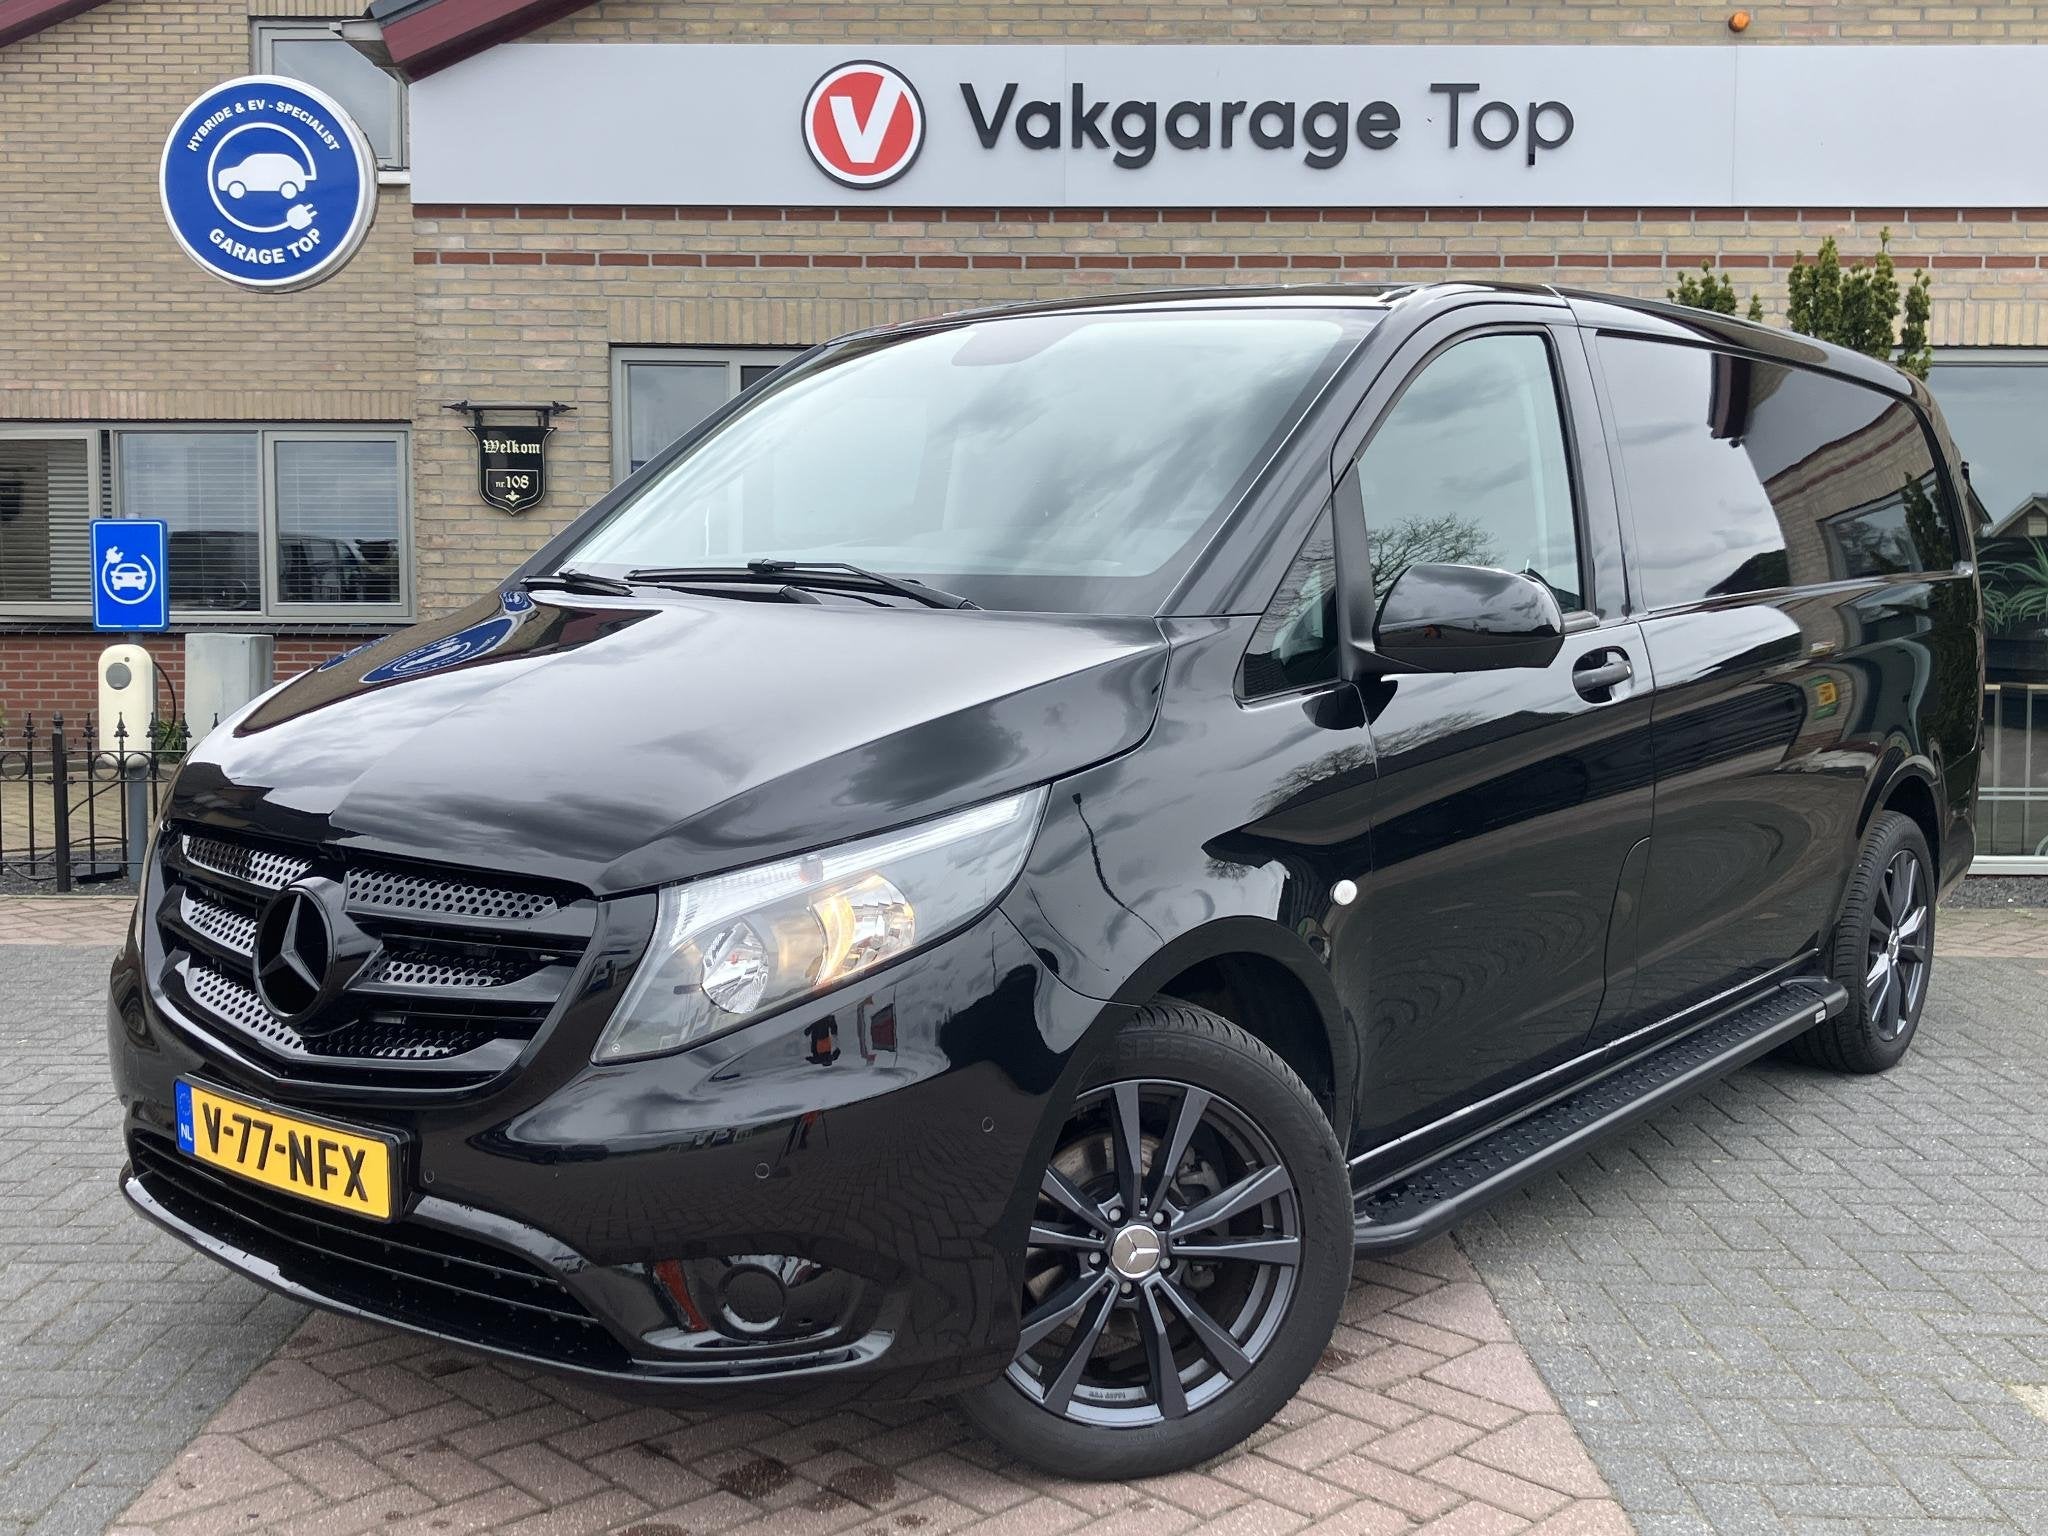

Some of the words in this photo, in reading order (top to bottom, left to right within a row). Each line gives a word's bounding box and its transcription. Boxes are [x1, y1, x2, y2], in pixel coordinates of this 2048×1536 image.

[187, 107, 233, 152] HYBRIDE
[234, 102, 246, 114] &
[248, 99, 266, 111] EV
[276, 101, 341, 151] SPECIALIST
[959, 83, 1401, 169] Vakgarage
[1430, 83, 1574, 166] Top
[209, 228, 286, 265] GARAGE
[287, 228, 321, 258] TOP
[482, 439, 540, 454] Welkom
[180, 1122, 193, 1142] NL
[202, 1102, 369, 1202] V-77-NFX
